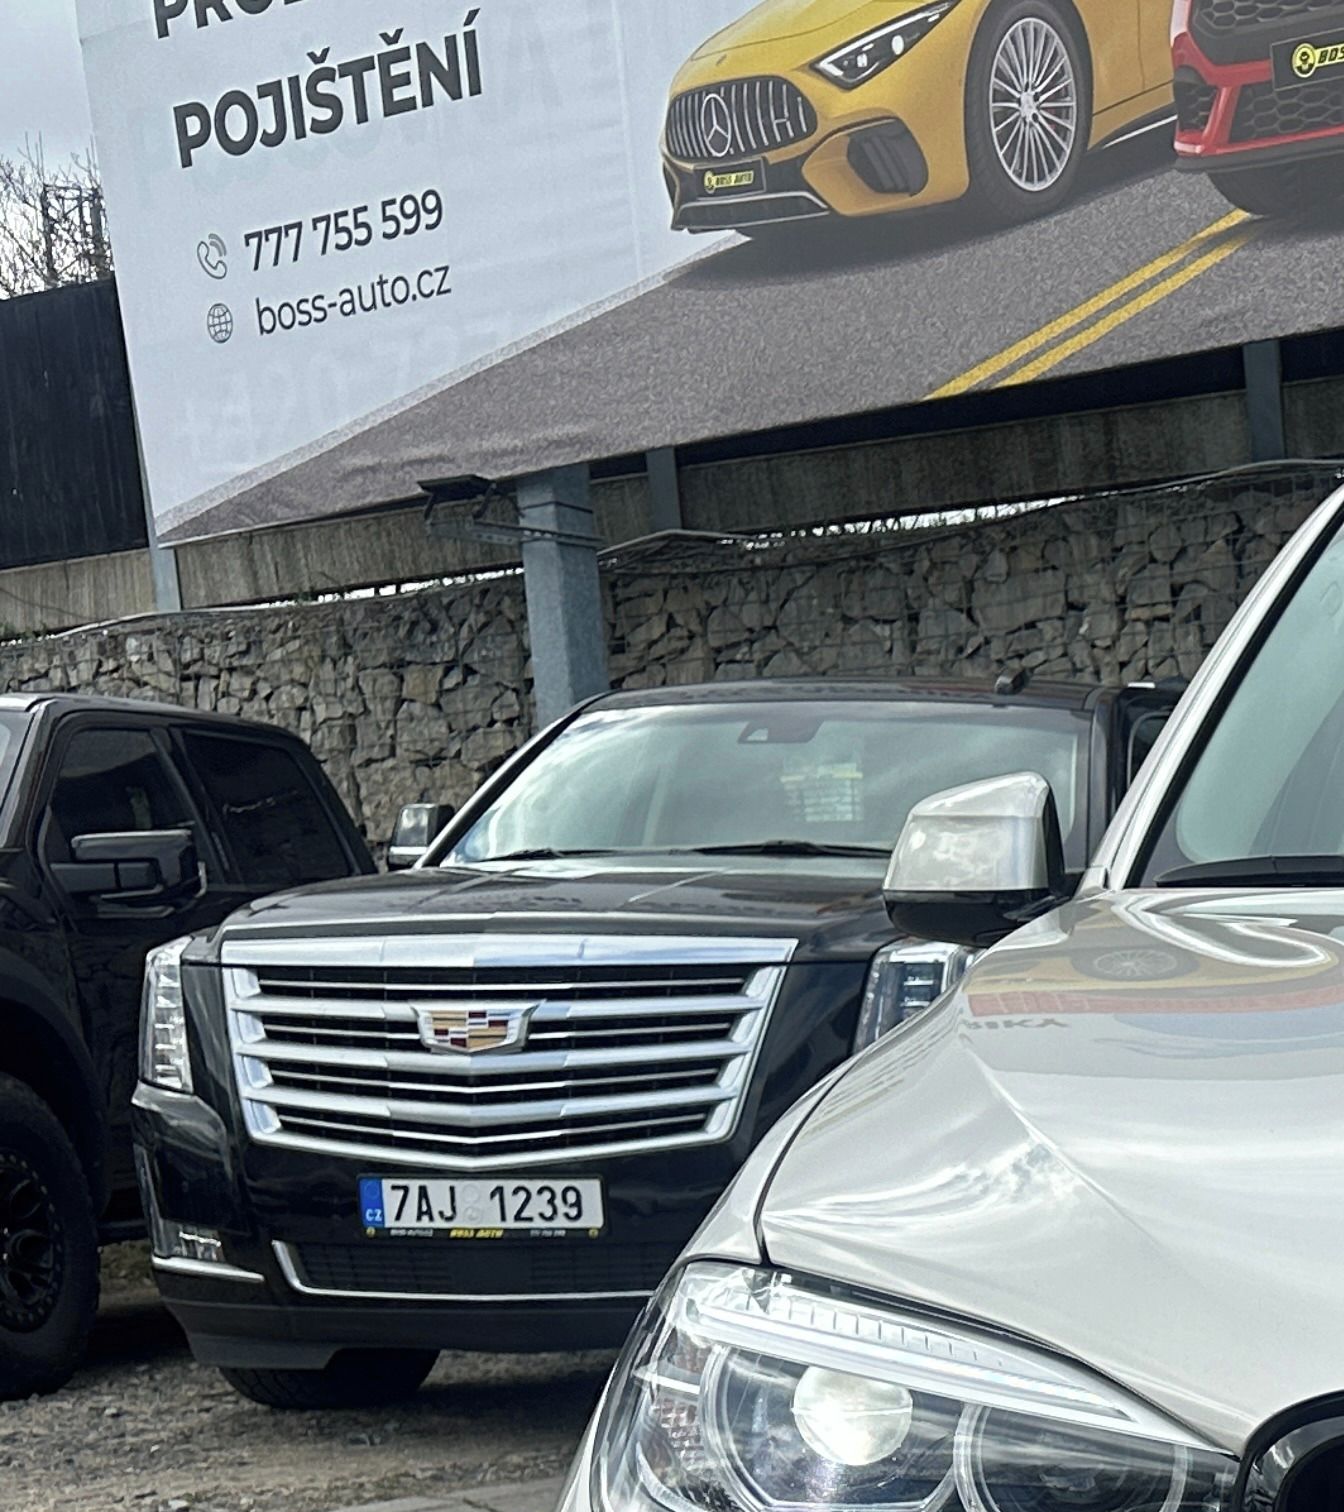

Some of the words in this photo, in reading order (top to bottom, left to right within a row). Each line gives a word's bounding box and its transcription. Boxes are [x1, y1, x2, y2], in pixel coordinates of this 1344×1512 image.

[173, 8, 482, 168] POJIŠTĚNÍ
[244, 221, 303, 271] 777
[312, 205, 373, 256] 755
[381, 188, 443, 240] 599
[255, 264, 452, 336] boss-auto.cz
[365, 1209, 383, 1222] CZ
[390, 1184, 457, 1223] 7AJ
[489, 1184, 583, 1223] 1239
